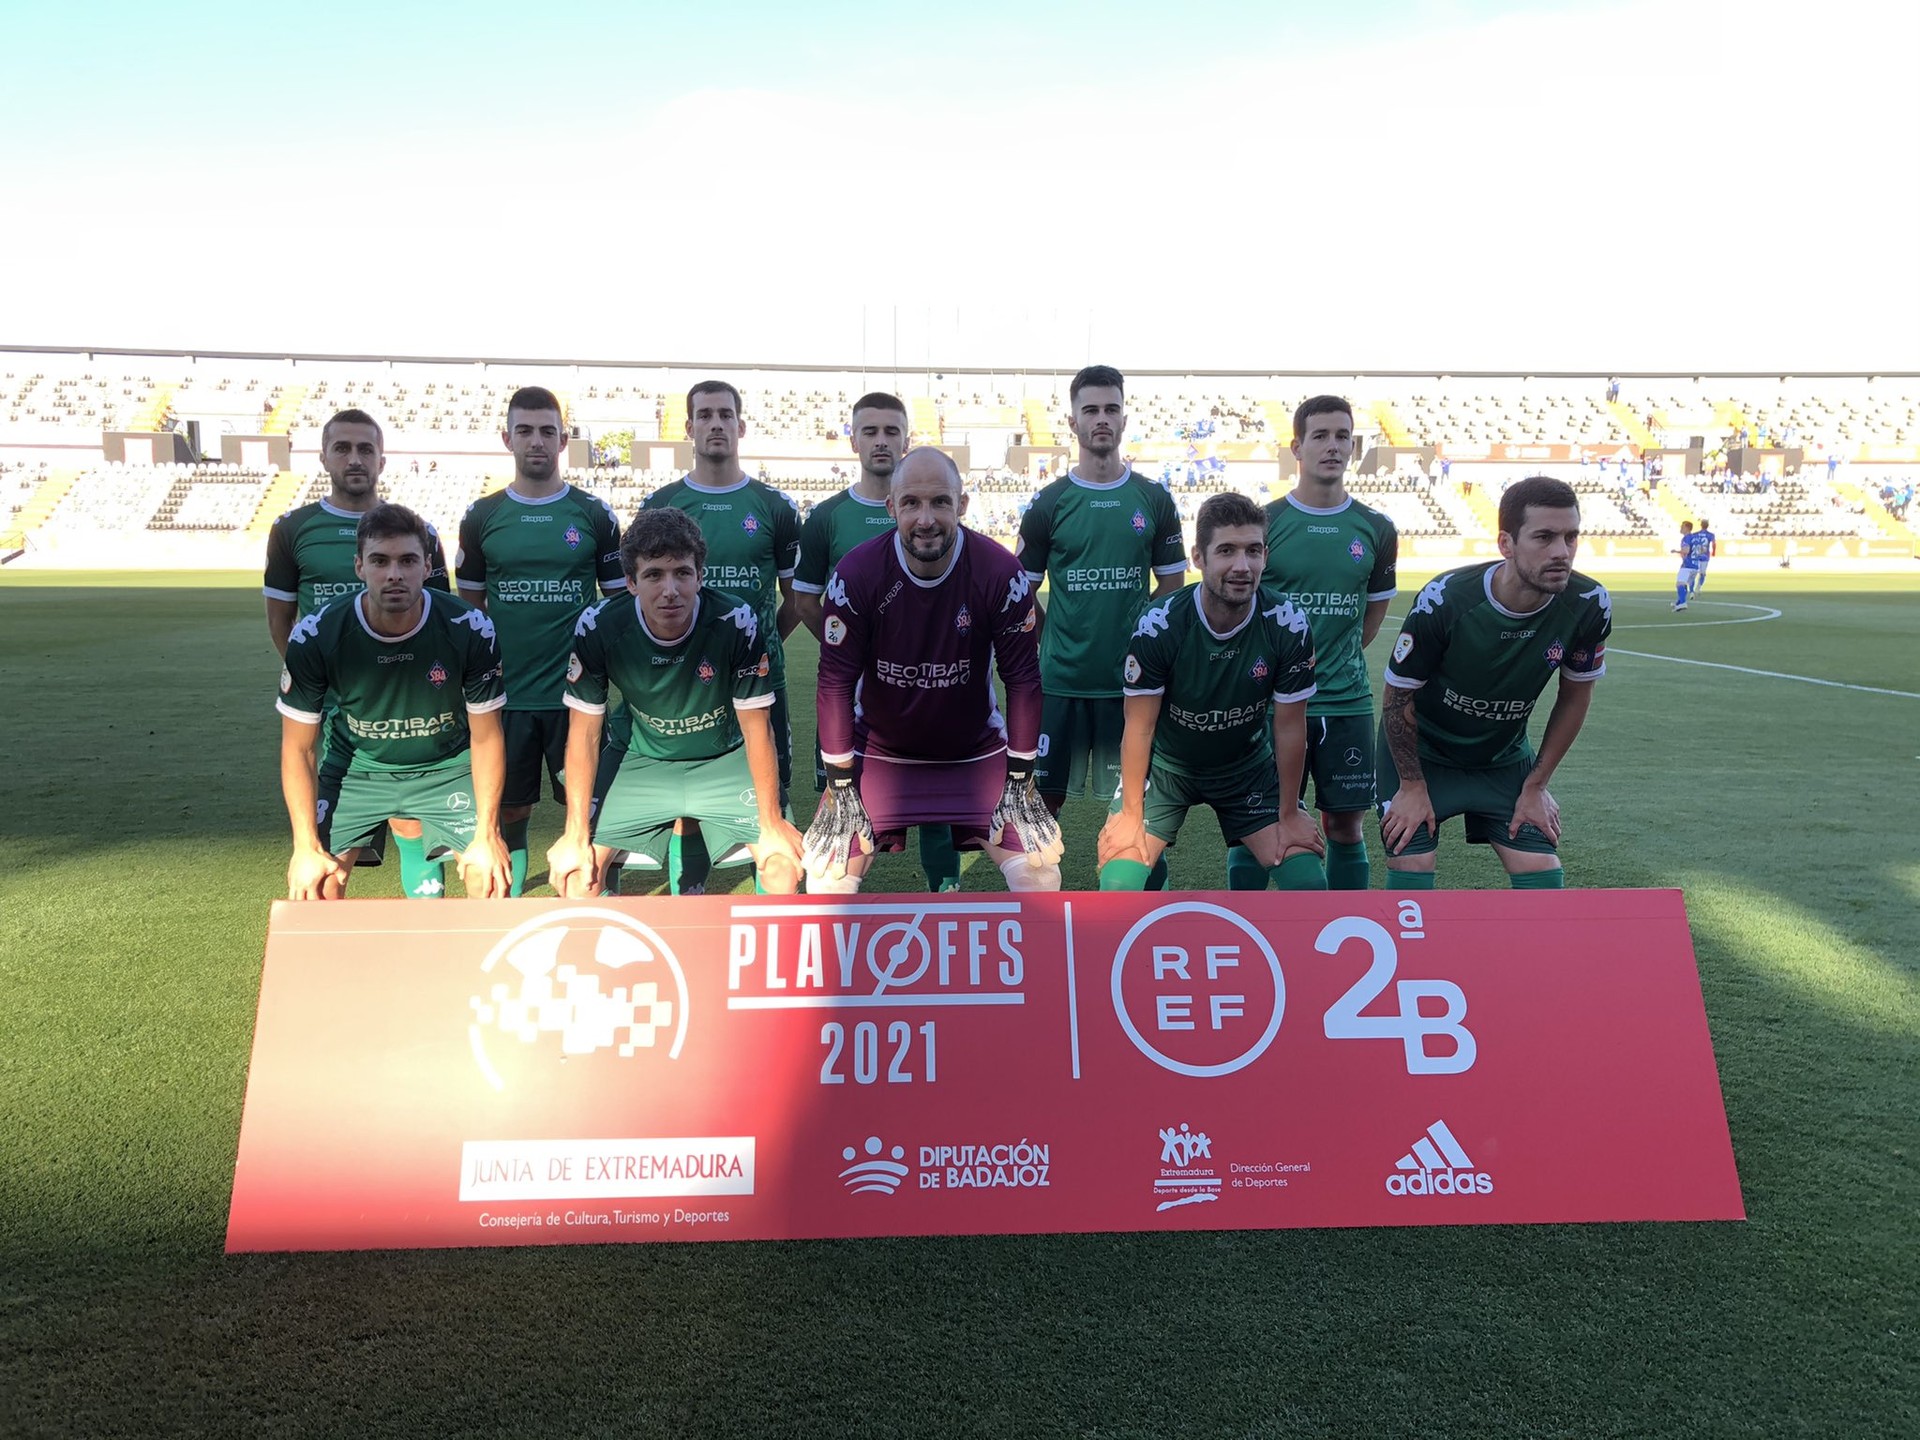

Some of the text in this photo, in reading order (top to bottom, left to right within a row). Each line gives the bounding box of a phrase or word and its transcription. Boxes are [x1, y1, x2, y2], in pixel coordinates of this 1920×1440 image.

[701, 566, 760, 579] OTIBAR
[1066, 567, 1142, 582] BEOTIBAR
[498, 580, 582, 593] BEOTIBAR
[498, 594, 573, 603] RECYCLING
[1305, 606, 1350, 616] YCLING
[877, 659, 970, 679] BEOTIBAR
[1169, 697, 1267, 724] BEOTIBAR
[1443, 698, 1531, 721] RECYCLIN
[1445, 688, 1537, 712] BEOTIBA
[347, 711, 454, 732] BEOTIBAR
[1037, 733, 1050, 757] 9
[728, 915, 1026, 992] PLAYOFFS
[820, 1020, 938, 1084] 2021
[919, 1138, 1049, 1167] DIPUTACIÓN
[471, 1154, 744, 1187] JUNTA DE EXTREMADURA
[919, 1165, 1050, 1188] DE BADAJOZ
[1160, 1168, 1214, 1177] Extremadura
[1230, 1162, 1311, 1173] Dirección General
[1153, 1187, 1178, 1195] Deporte
[1231, 1177, 1288, 1189] de Deportes
[1385, 1166, 1494, 1196] adidas
[479, 1212, 542, 1230] Consejería
[546, 1211, 561, 1226] de
[612, 1210, 660, 1224] Turismo
[663, 1213, 671, 1227] y
[674, 1208, 730, 1226] Deportes
